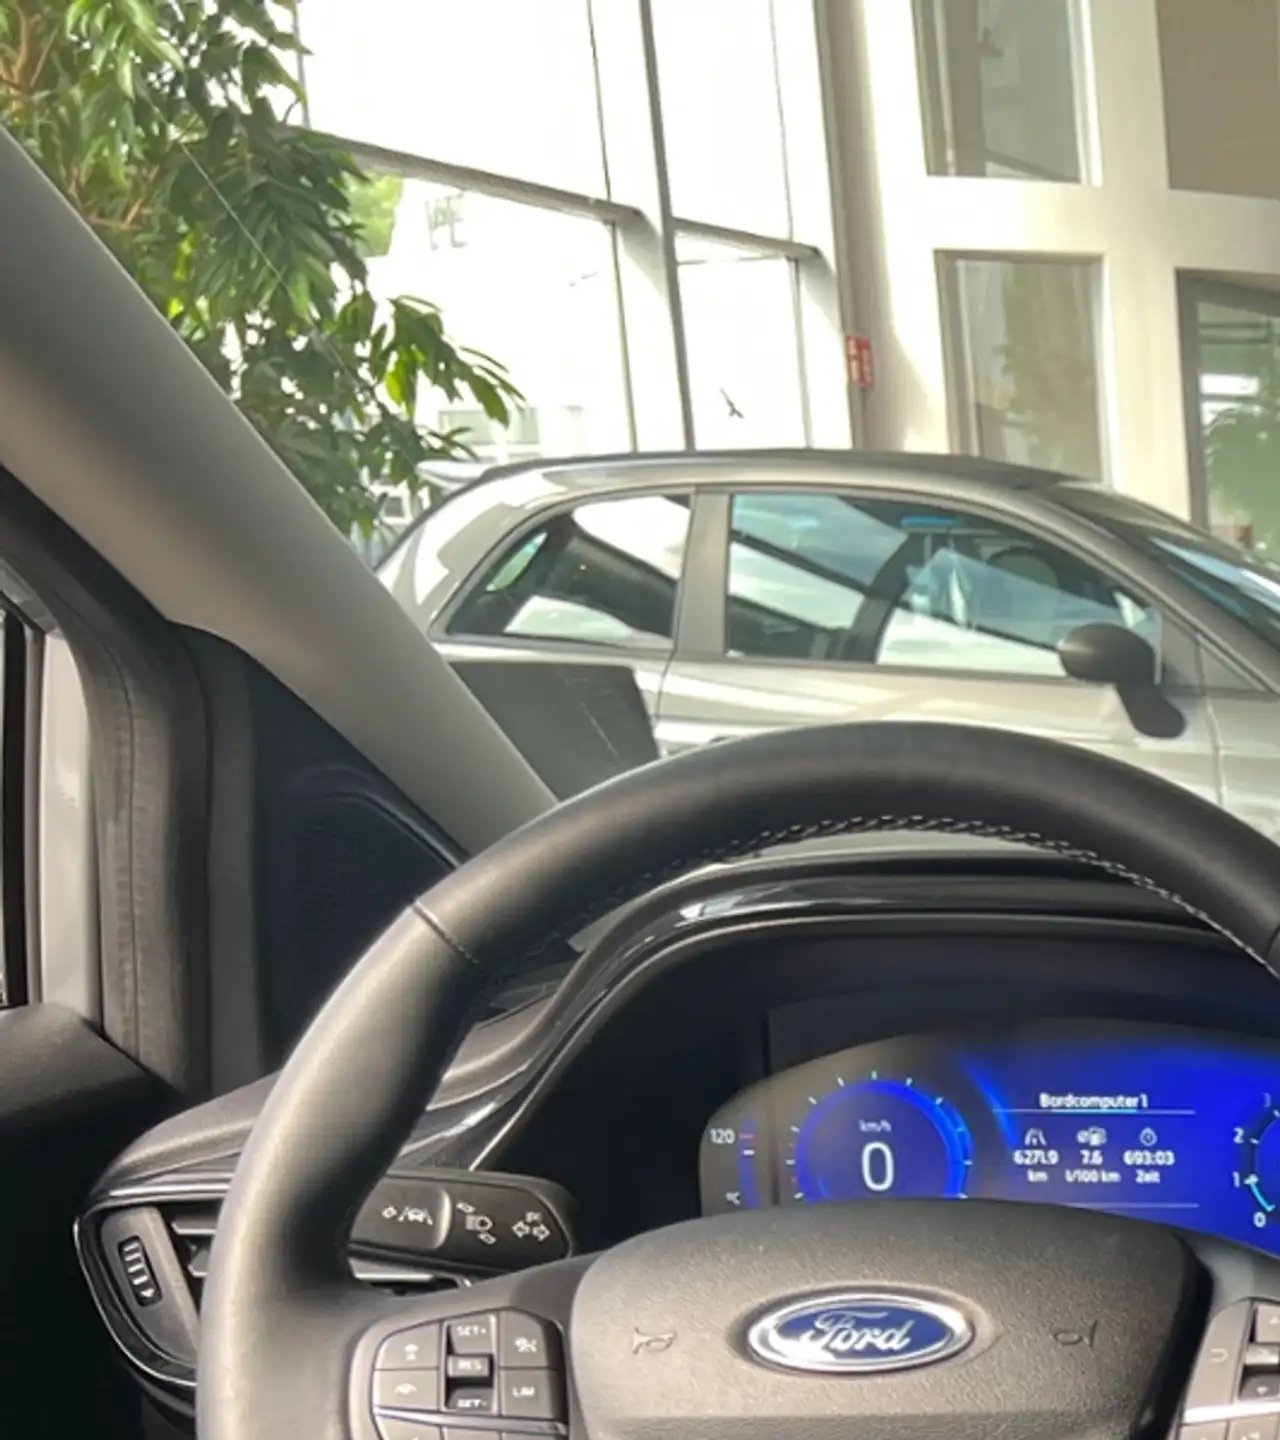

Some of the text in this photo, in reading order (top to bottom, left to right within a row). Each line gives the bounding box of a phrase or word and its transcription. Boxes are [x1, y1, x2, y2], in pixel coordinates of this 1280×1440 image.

[1039, 1092, 1149, 1109] Bordcomputer 1
[859, 1118, 892, 1133] km/h
[710, 1128, 735, 1145] 120
[1232, 1127, 1245, 1144] 2
[861, 1141, 895, 1193] 0
[1027, 1169, 1049, 1183] km
[1253, 1212, 1267, 1228] 0
[803, 1309, 916, 1352] Ford
